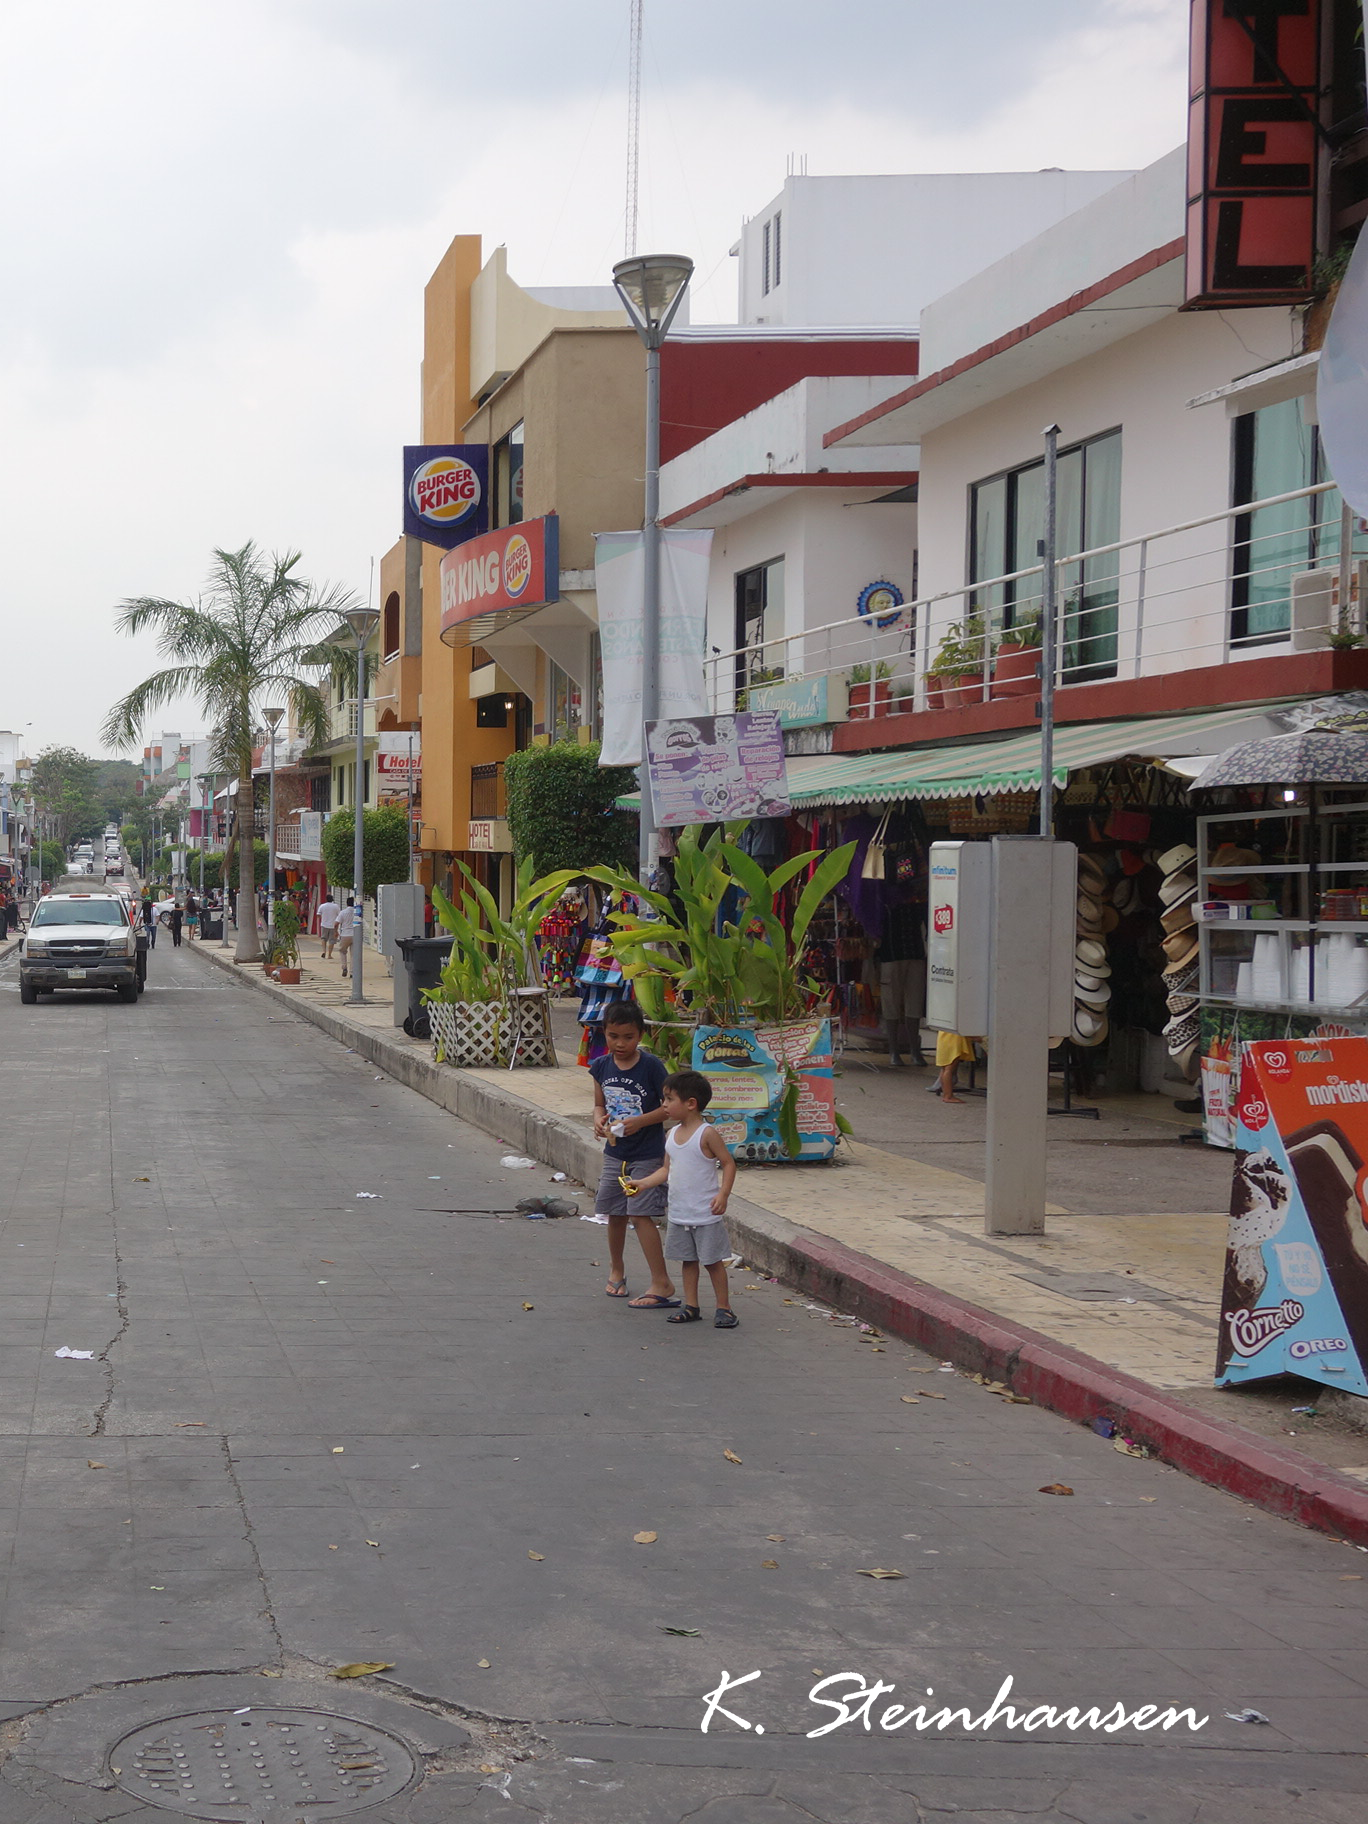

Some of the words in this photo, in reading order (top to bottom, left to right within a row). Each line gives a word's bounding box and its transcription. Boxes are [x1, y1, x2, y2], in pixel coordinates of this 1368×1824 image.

[417, 468, 473, 495] BURGER
[420, 481, 475, 514] KING
[505, 543, 527, 570] BURGER
[458, 550, 500, 606] KING
[506, 554, 529, 587] KING
[740, 745, 780, 755] Reparación
[755, 754, 779, 763] relojes
[931, 964, 954, 977] Contrata
[805, 1024, 818, 1034] de
[732, 1035, 742, 1045] de
[620, 1077, 634, 1085] OFF
[723, 1085, 763, 1093] sombreros
[1225, 1299, 1304, 1357] Cornetto
[1290, 1338, 1347, 1359] OREO
